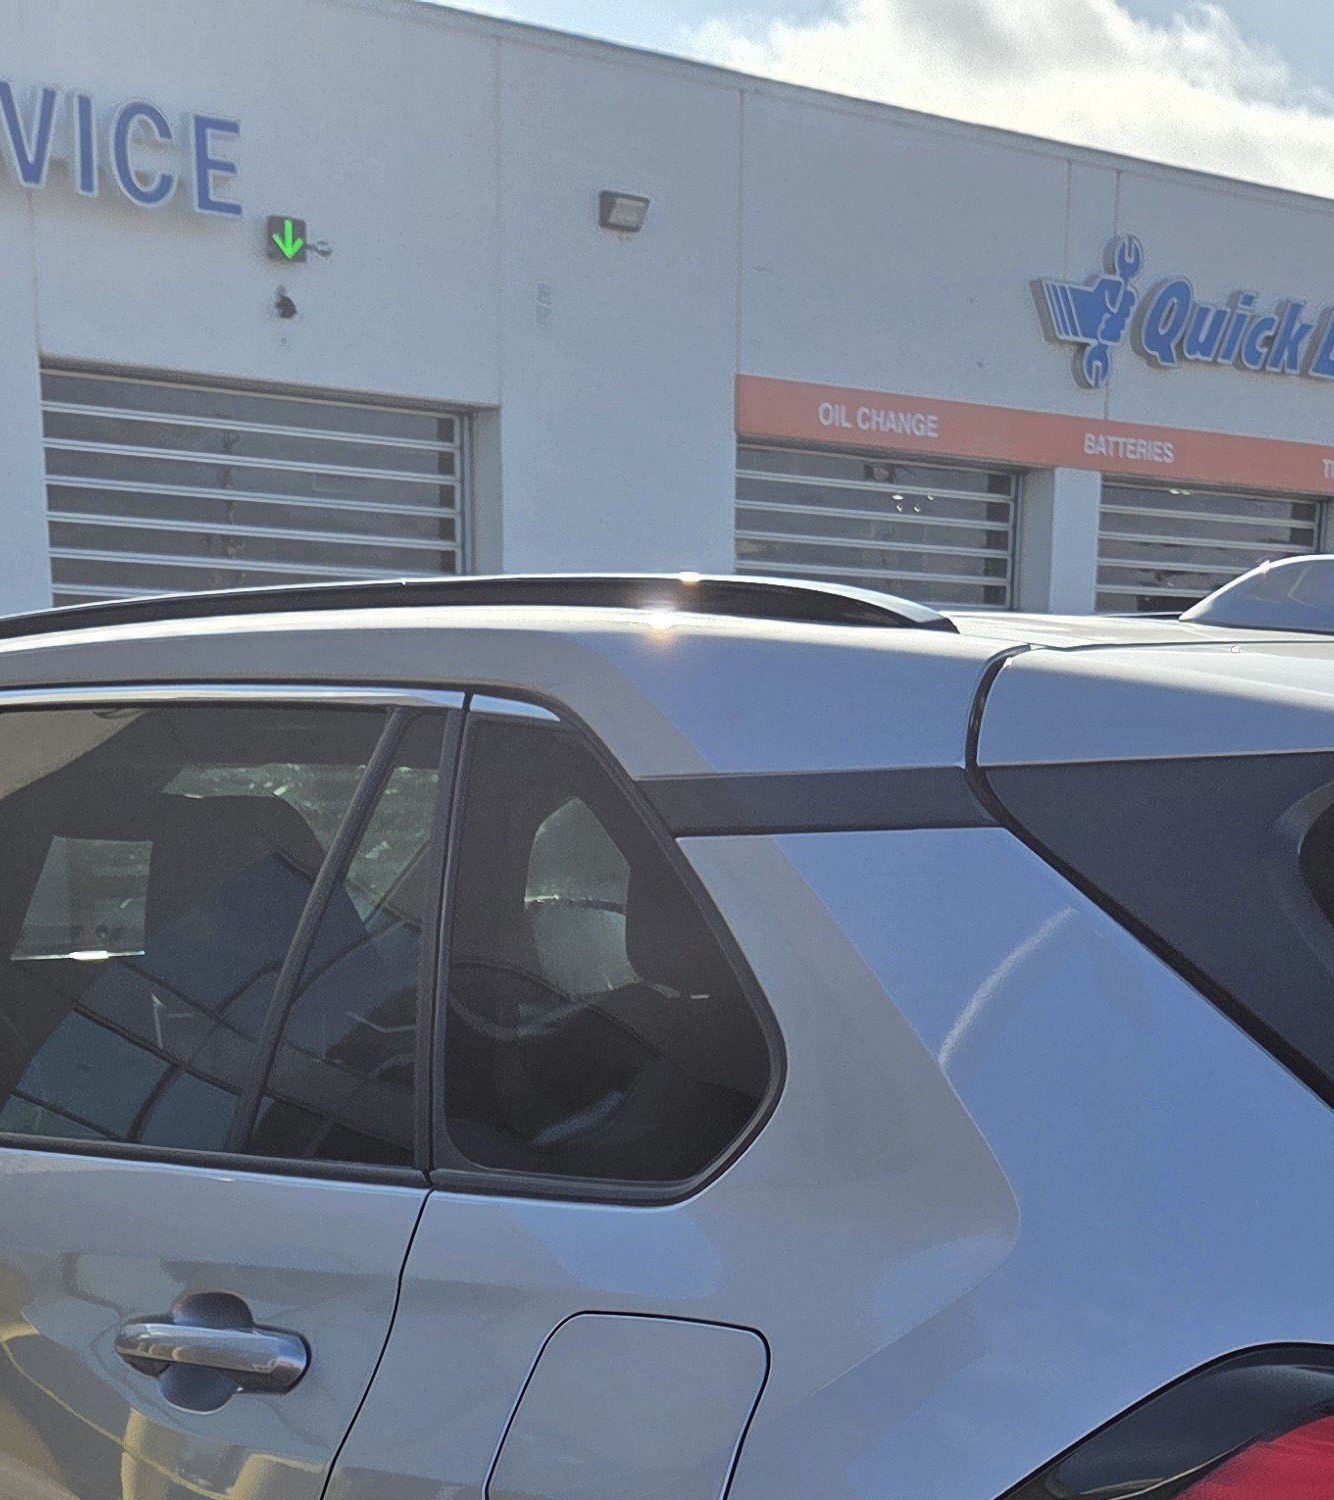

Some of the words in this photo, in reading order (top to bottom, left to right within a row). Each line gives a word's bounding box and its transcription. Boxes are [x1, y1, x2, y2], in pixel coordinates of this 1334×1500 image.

[1142, 279, 1314, 375] Quick
[818, 401, 852, 428] OIL
[856, 406, 939, 438] CHANGE
[1084, 432, 1174, 464] BATTERIES
